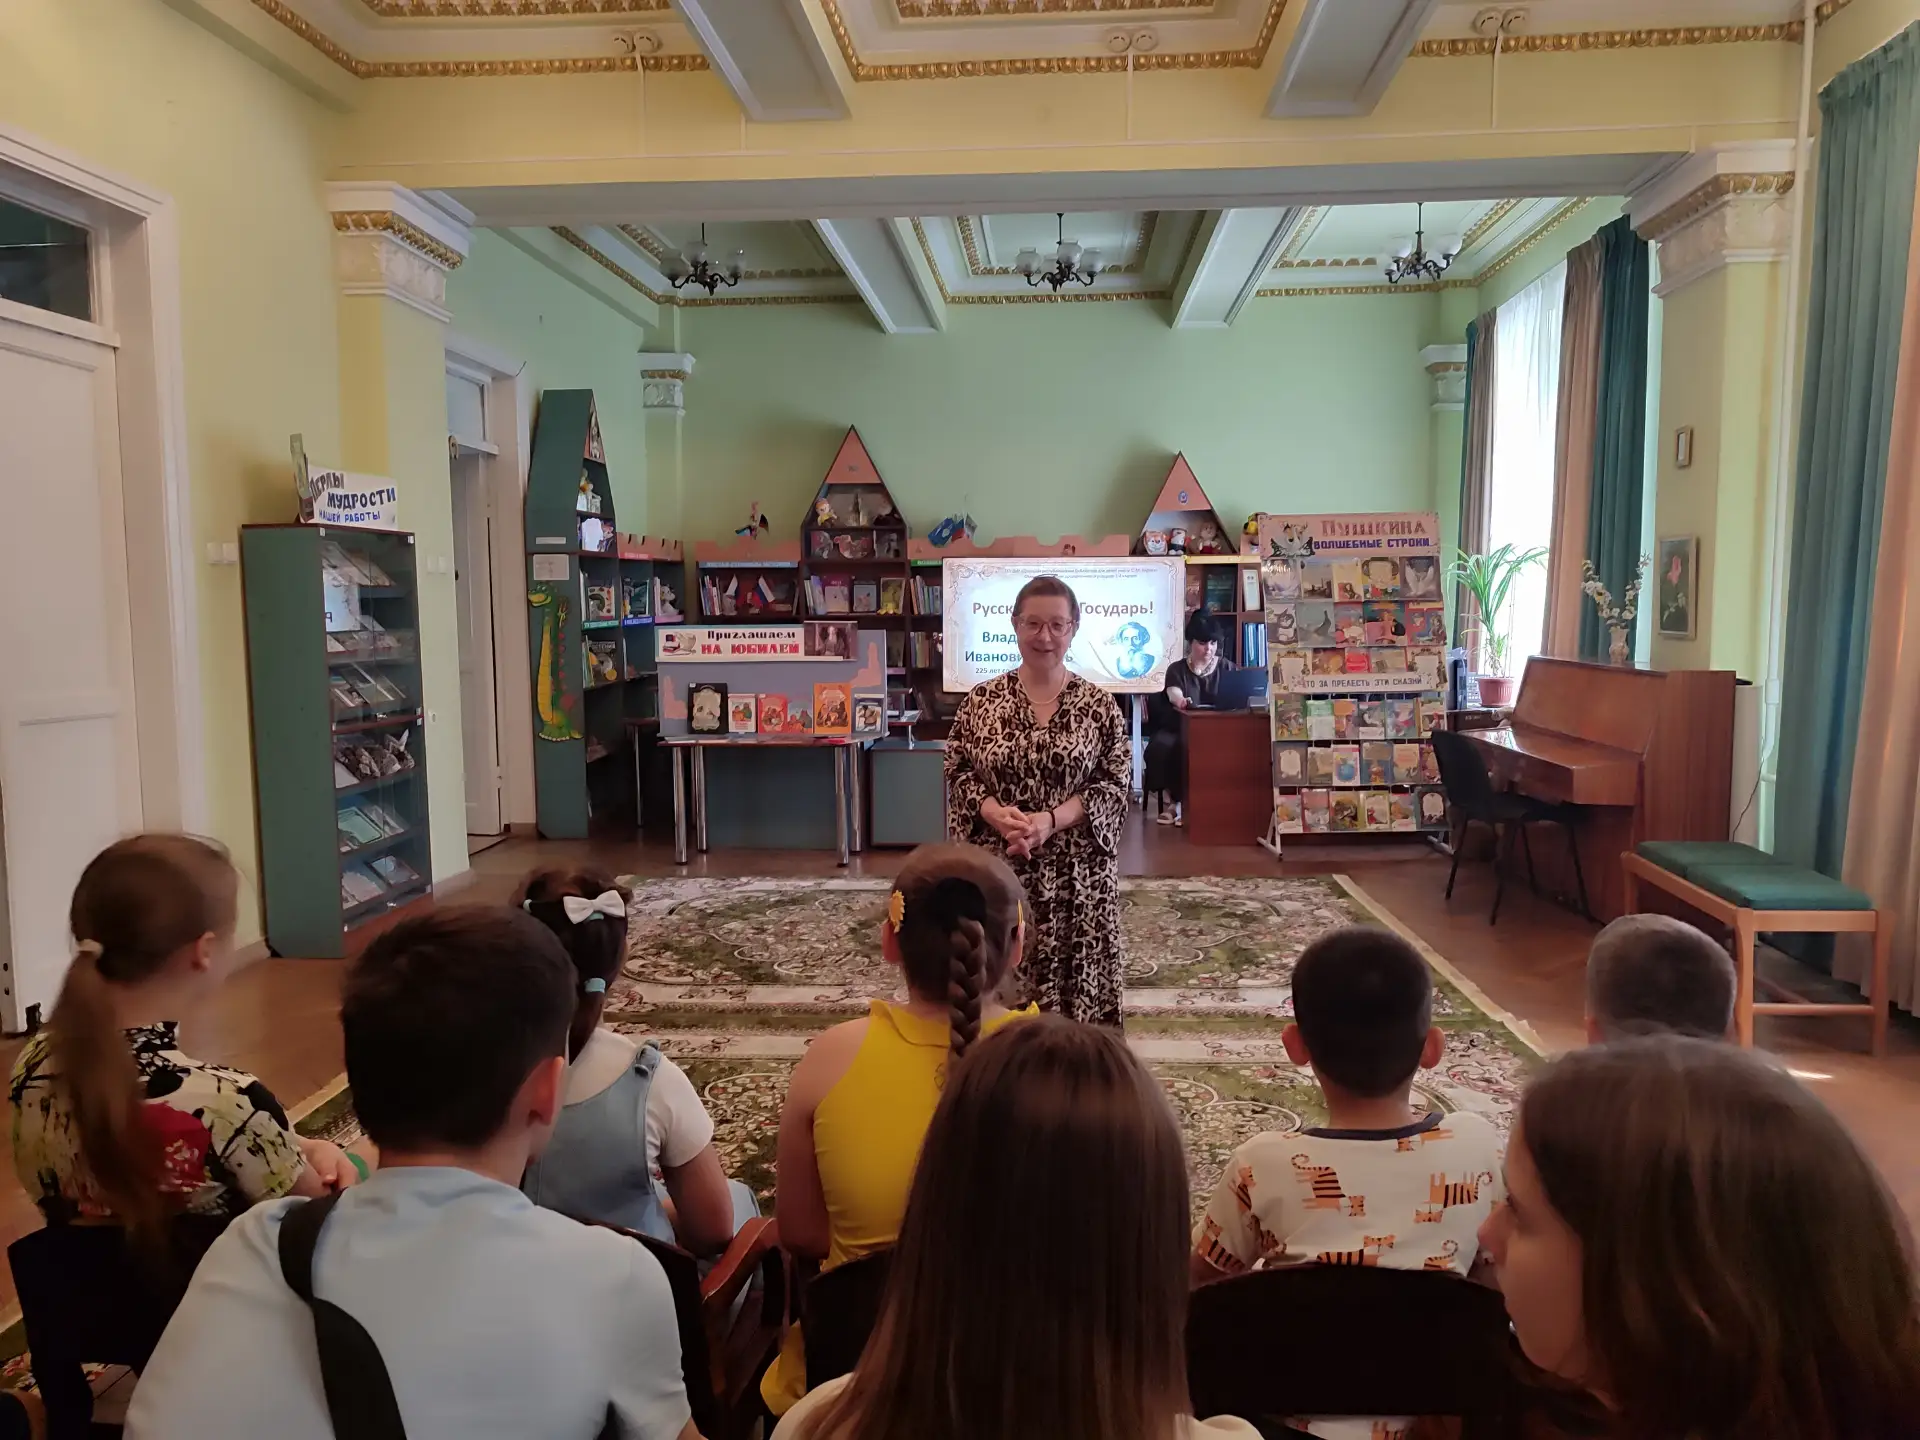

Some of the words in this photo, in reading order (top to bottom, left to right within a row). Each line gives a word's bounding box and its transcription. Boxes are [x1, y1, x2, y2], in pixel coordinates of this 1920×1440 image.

[327, 487, 396, 512] МУДРОСТИ
[319, 509, 341, 523] НАШЕЙ
[345, 511, 380, 523] РАБОТЫ
[1321, 520, 1427, 536] ПУШКИНА
[1313, 539, 1383, 549] ВОЛШЕБНЫЕ
[1387, 538, 1430, 547] СТРОКИ
[972, 602, 1014, 617] Русск
[1079, 601, 1153, 617] Государь!
[707, 630, 796, 641] Приглашаем
[982, 631, 1017, 645] Влад
[701, 644, 723, 654] НА
[731, 641, 800, 654] ЮБИЛЕЙ
[965, 650, 1022, 662] Иванови
[1319, 680, 1329, 688] ЗА
[1331, 679, 1370, 688] ПРЕЛЕСТЬ
[1374, 678, 1390, 687] ЭТИ
